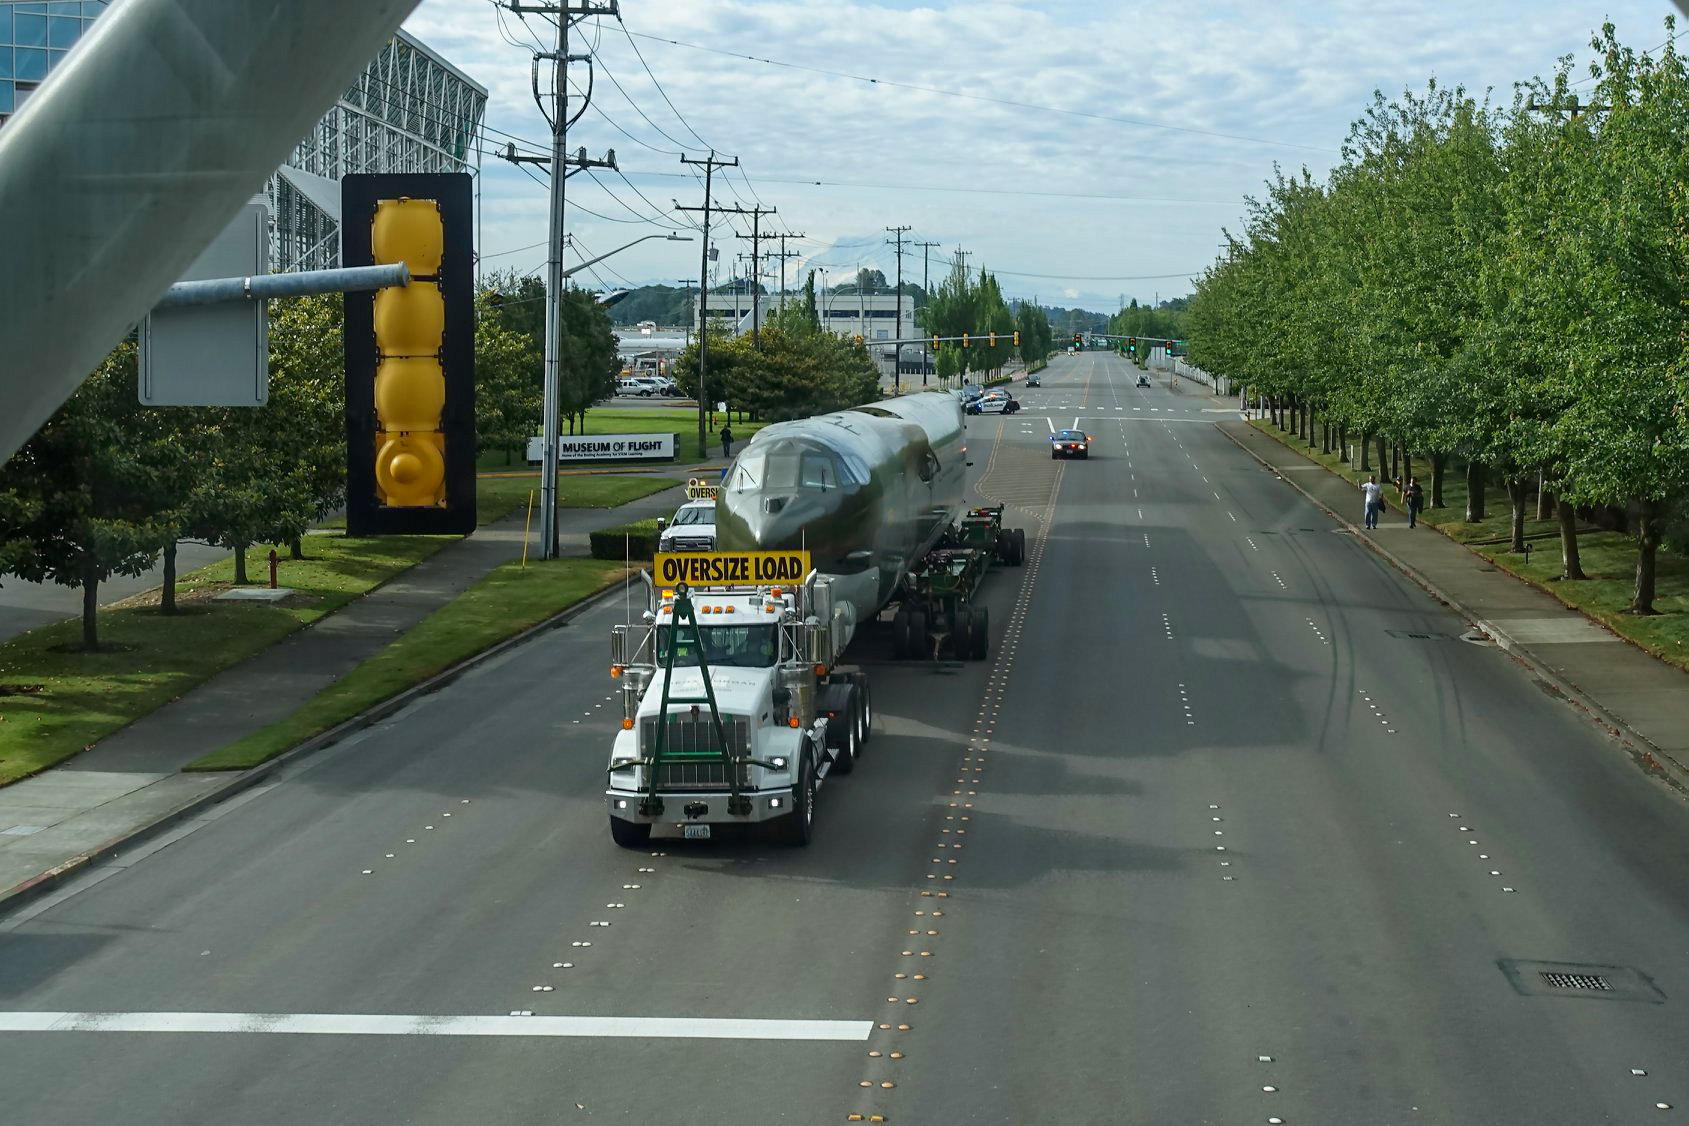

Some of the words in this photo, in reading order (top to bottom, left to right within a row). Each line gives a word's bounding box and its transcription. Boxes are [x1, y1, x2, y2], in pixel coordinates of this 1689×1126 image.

[562, 442, 611, 453] MUSEUM
[613, 442, 626, 451] OF
[628, 441, 663, 451] FLIGHT
[663, 557, 750, 582] OVERSIZE
[754, 556, 803, 581] LOAD
